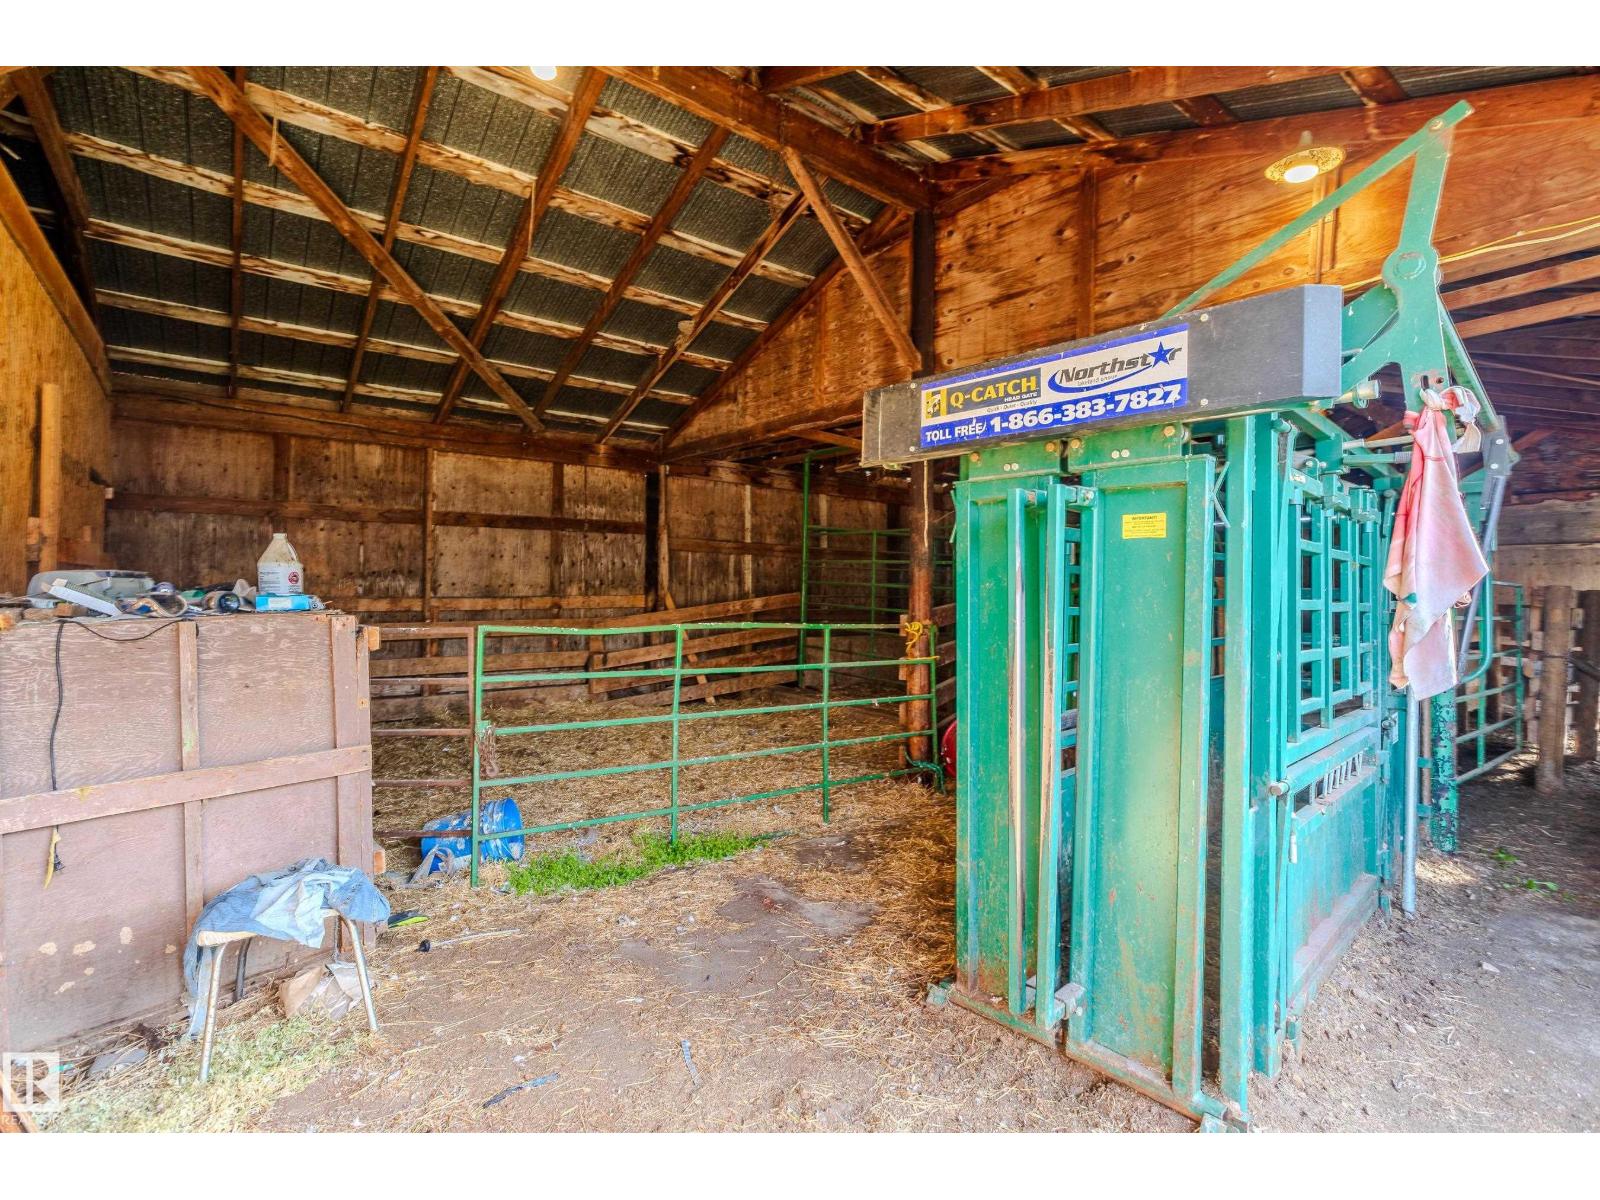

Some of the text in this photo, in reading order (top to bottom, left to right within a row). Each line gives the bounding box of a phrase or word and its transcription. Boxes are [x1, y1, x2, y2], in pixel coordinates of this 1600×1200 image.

[1060, 342, 1182, 384] Northstr
[950, 375, 1037, 408] Q-CATCH
[925, 384, 1182, 442] TOLL FREE 1-866-383-7827
